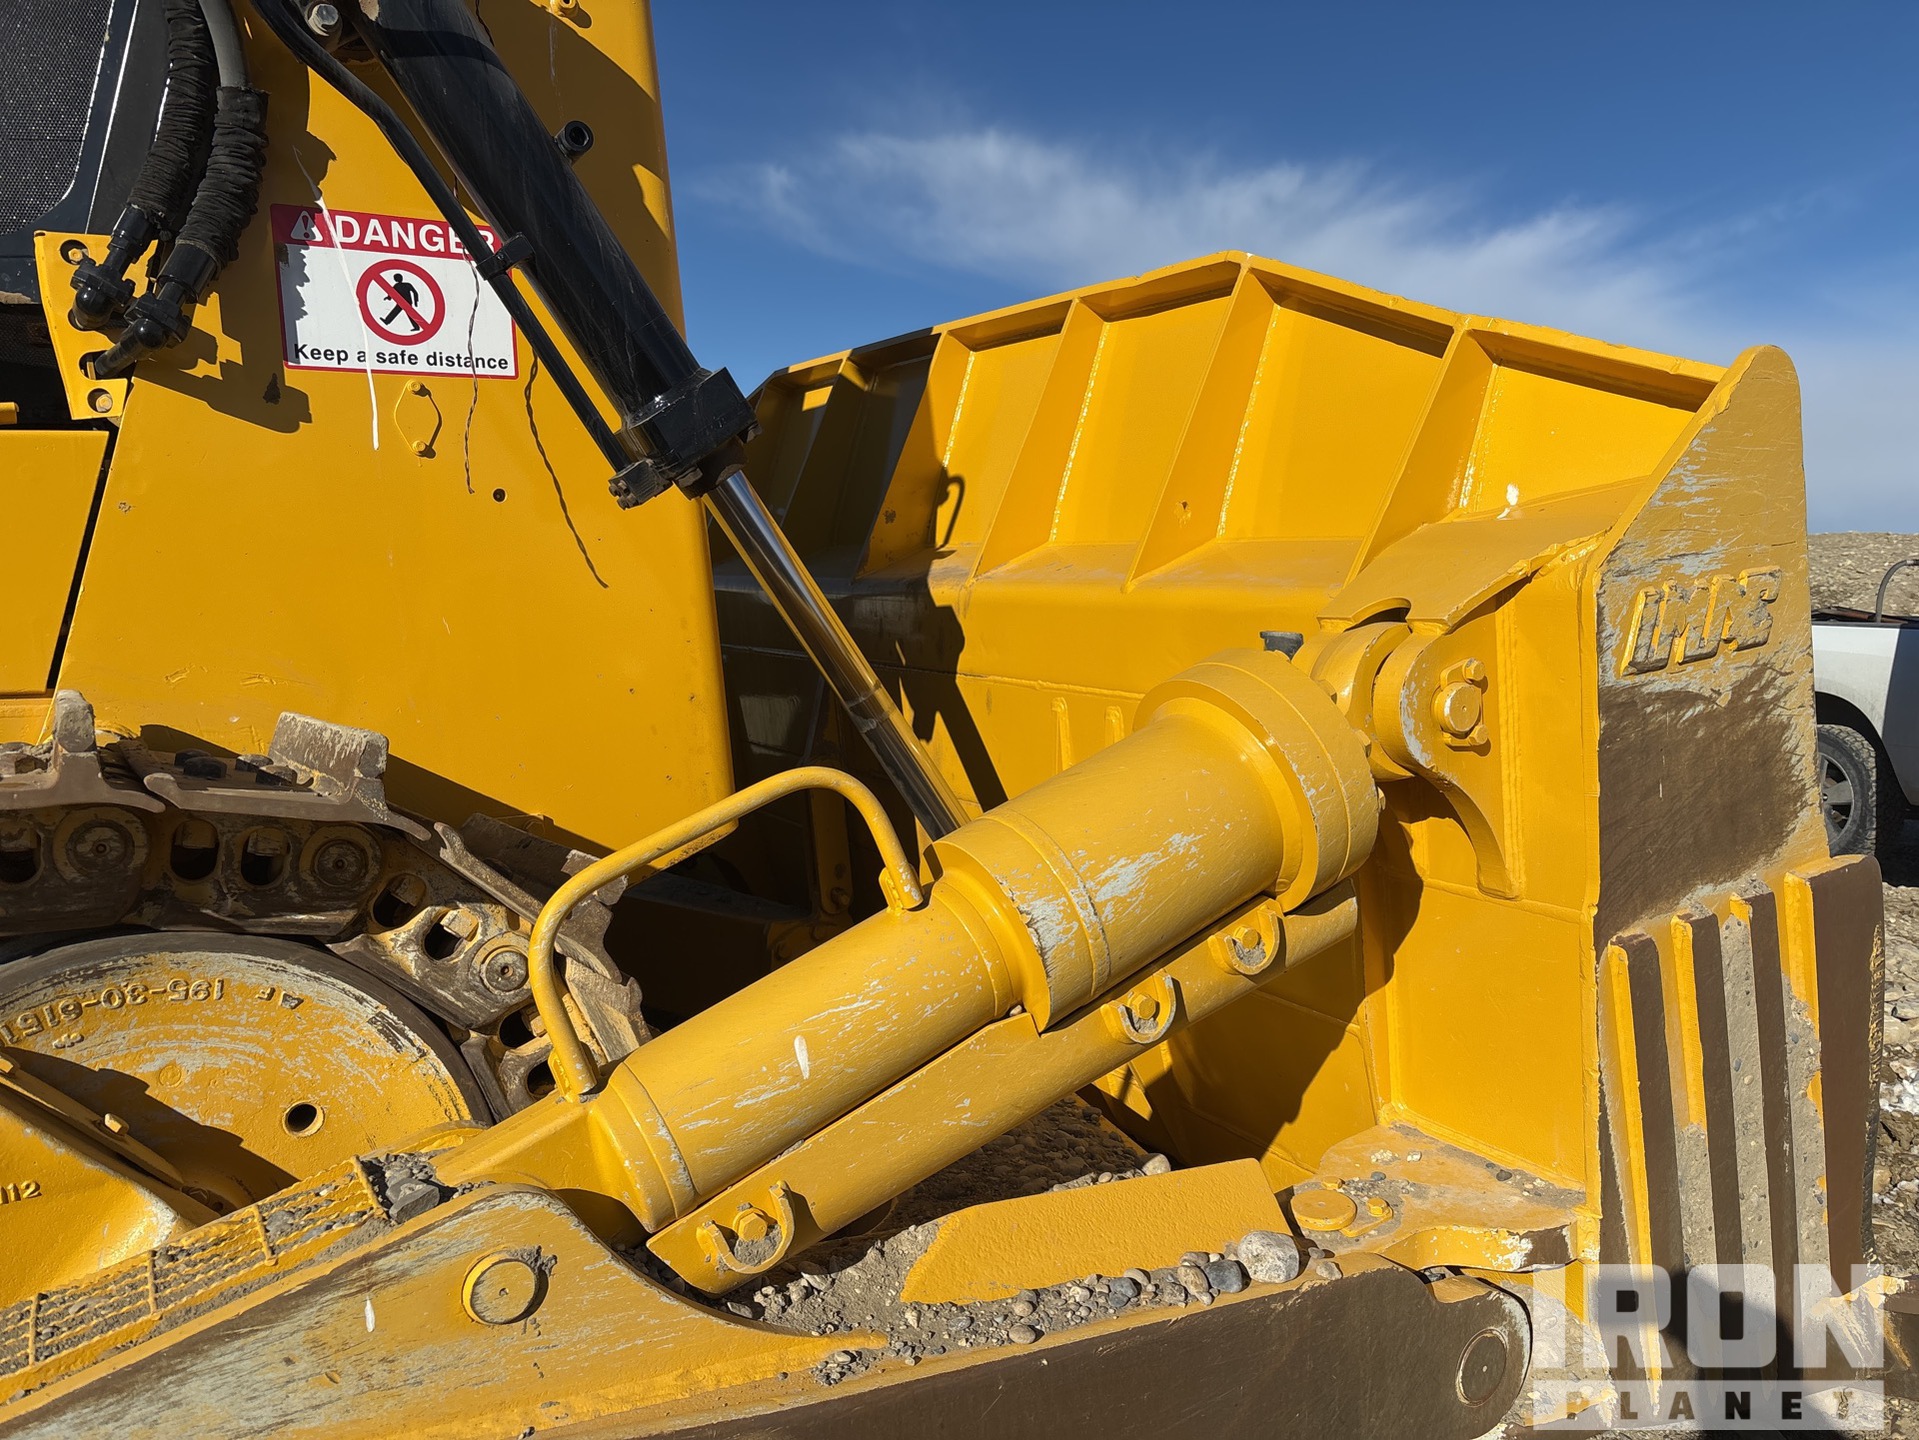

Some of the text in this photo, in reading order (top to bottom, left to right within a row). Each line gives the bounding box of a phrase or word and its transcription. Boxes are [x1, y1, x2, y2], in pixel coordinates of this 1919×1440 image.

[294, 343, 349, 365] Keep
[375, 349, 419, 366] safe
[425, 351, 509, 370] distance
